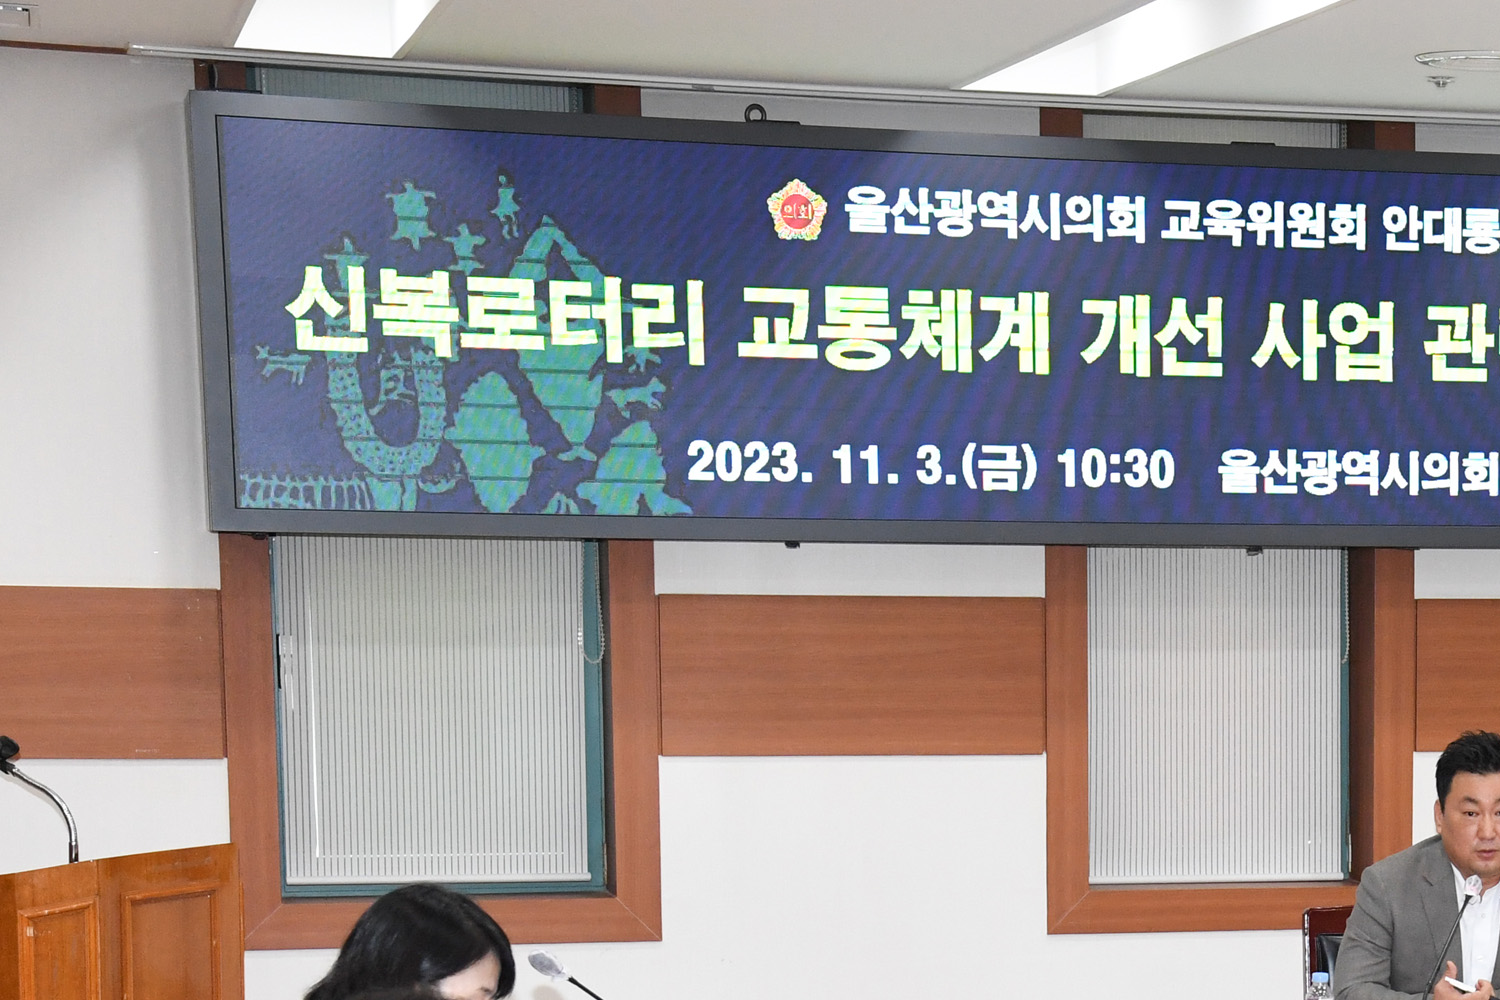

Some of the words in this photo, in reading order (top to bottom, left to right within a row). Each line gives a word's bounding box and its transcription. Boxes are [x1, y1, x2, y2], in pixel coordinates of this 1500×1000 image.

[844, 186, 1146, 244] 울산광역시의회
[1161, 200, 1367, 251] 교육위원회
[286, 266, 705, 366] 신복로터리
[738, 287, 1050, 375] 교통체계
[1081, 295, 1224, 378] 개선
[1252, 300, 1395, 383] 사업
[687, 440, 809, 484] 2023.
[833, 445, 900, 486] 11.
[917, 443, 1038, 492] 3.(금)
[1058, 449, 1176, 490] 10:30
[1218, 450, 1500, 498] 울산광역시의회
